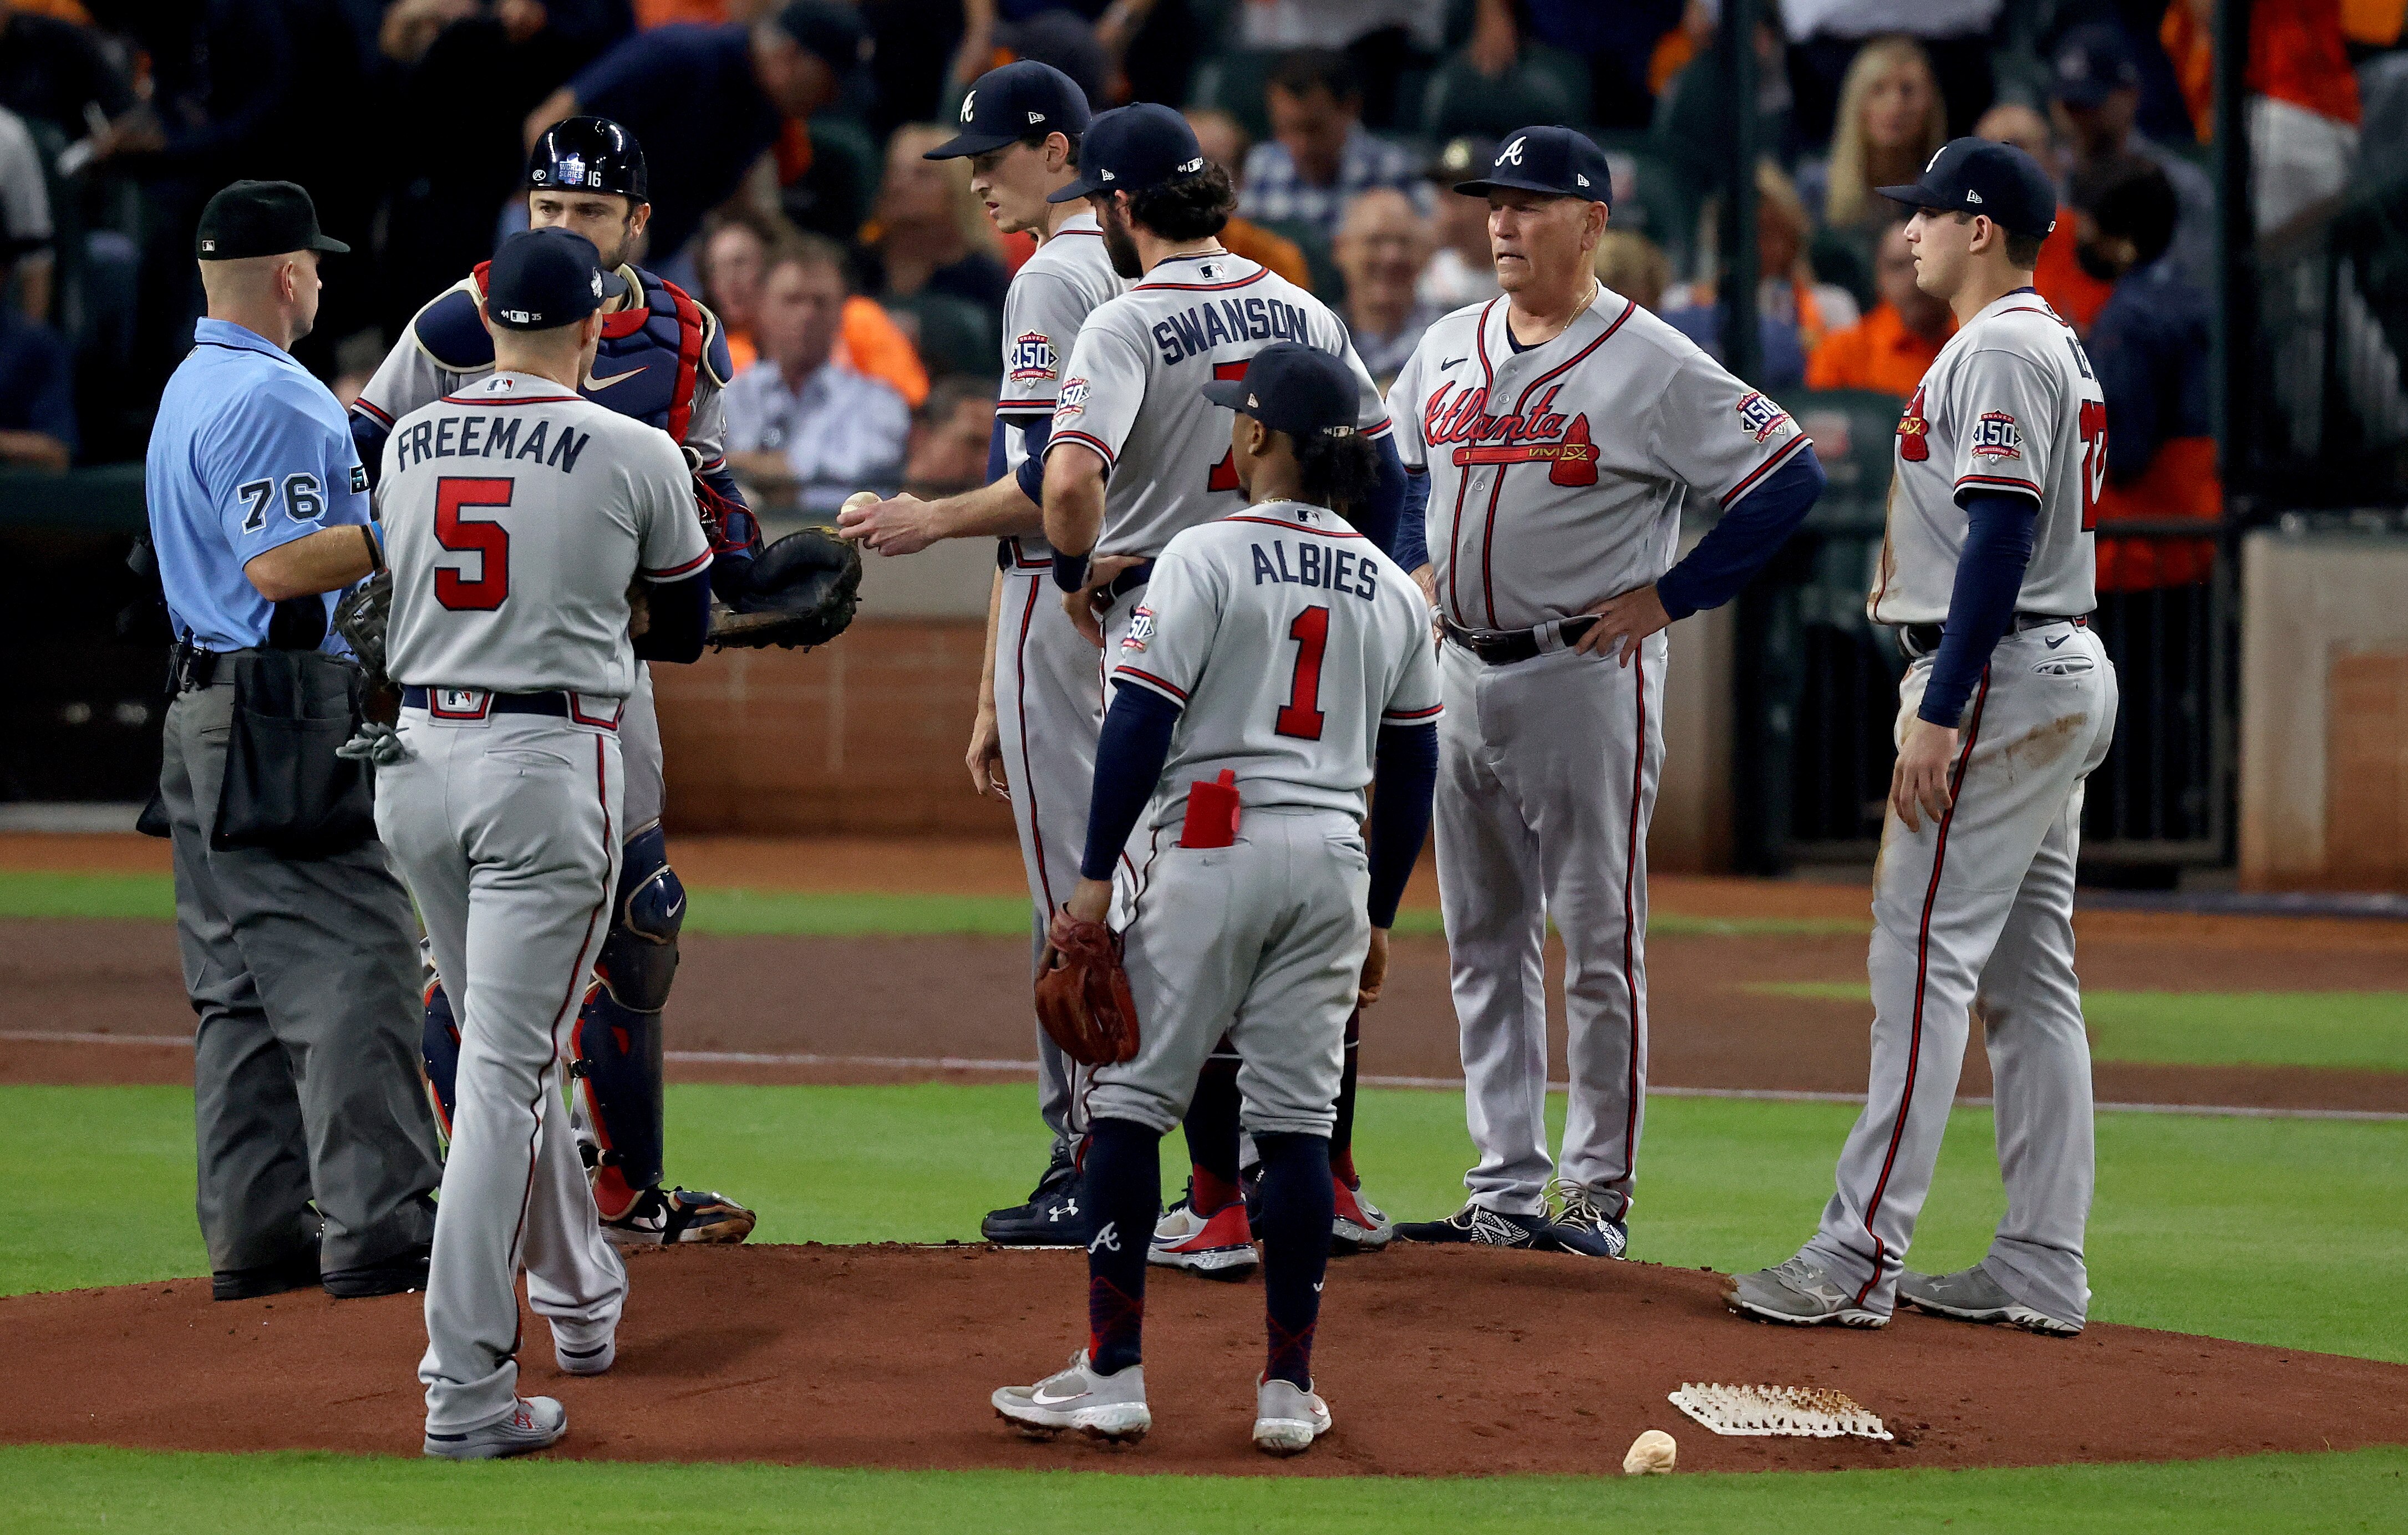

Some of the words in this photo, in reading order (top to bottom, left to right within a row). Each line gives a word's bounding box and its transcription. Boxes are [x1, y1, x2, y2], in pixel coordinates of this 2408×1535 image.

[559, 170, 583, 179] SERIES
[1495, 136, 1527, 166] A
[587, 170, 601, 187] 16
[1152, 298, 1309, 365] SWANSON
[1014, 343, 1050, 369] 150
[1424, 380, 1569, 448] Atlanta
[1740, 396, 1780, 433] 150
[1976, 420, 2016, 447] 150
[398, 416, 591, 474] FREEMAN
[237, 472, 327, 535] 76
[434, 476, 515, 611] 5
[1251, 540, 1378, 601] ALBIES
[1274, 604, 1330, 742] 1
[1087, 1221, 1121, 1254] A
